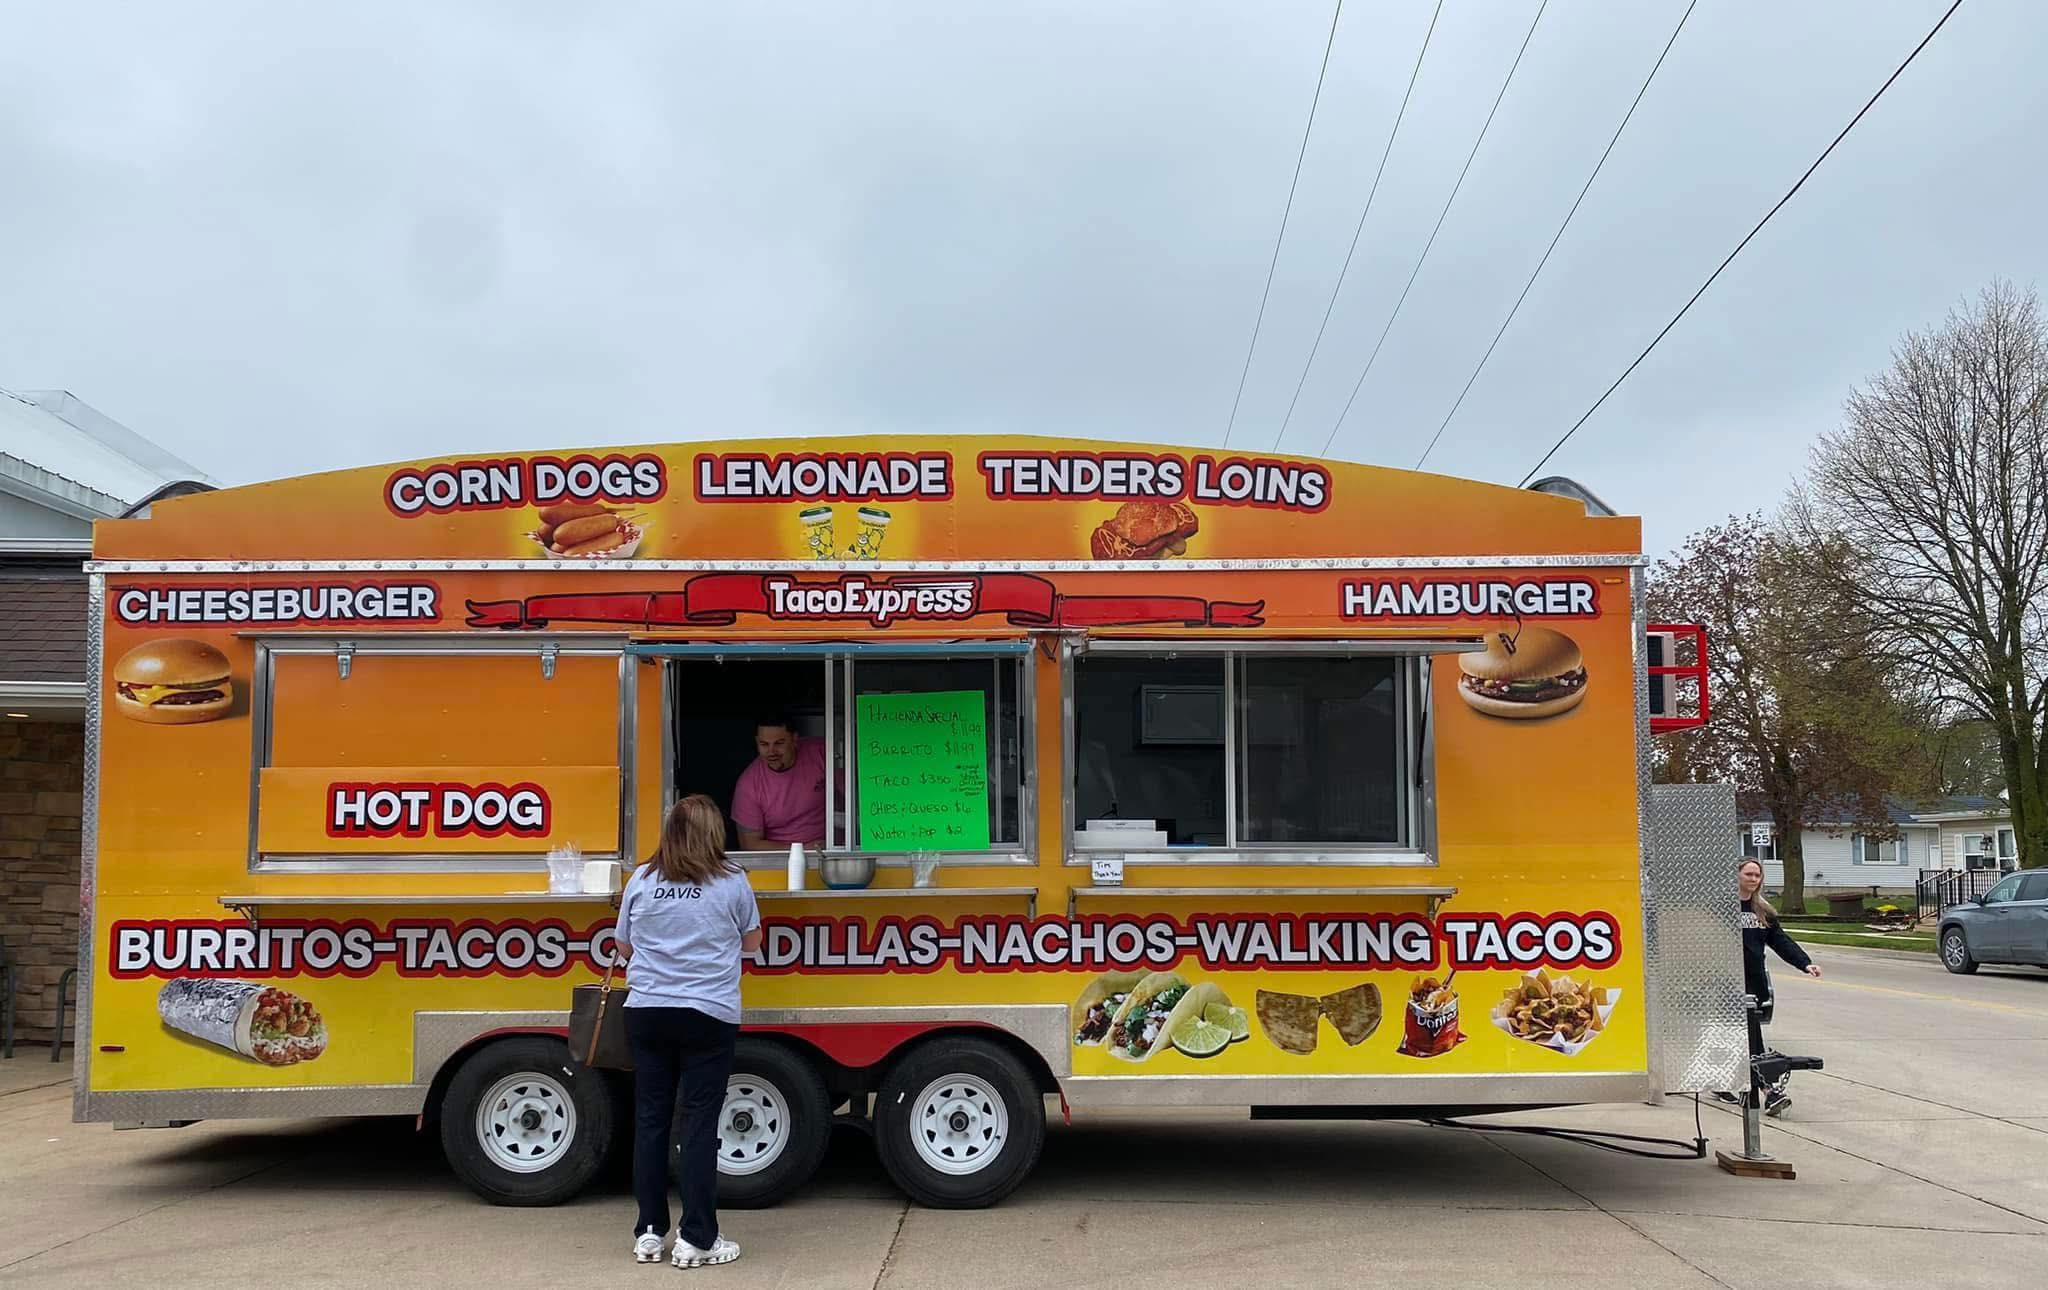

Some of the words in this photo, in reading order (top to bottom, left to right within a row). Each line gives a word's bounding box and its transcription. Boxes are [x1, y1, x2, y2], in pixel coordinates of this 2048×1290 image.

[391, 464, 520, 511] CORN
[535, 461, 660, 499] DOGS
[701, 458, 947, 495] LEMONADE
[985, 458, 1182, 496] TENDERS
[1196, 463, 1325, 507] LOINS
[118, 587, 436, 621] CHEESEBURGER
[769, 580, 975, 621] TacoExpress
[1344, 582, 1595, 615] HAMBURGER
[869, 774, 910, 786] TACO
[334, 789, 430, 827] HOT
[443, 789, 544, 827] DOG
[870, 802, 898, 816] CHIPS
[908, 803, 949, 814] QUESO
[870, 826, 906, 840] Water
[1754, 834, 1769, 844] 25
[653, 887, 702, 900] DAVIS
[1445, 920, 1614, 962] TACOS
